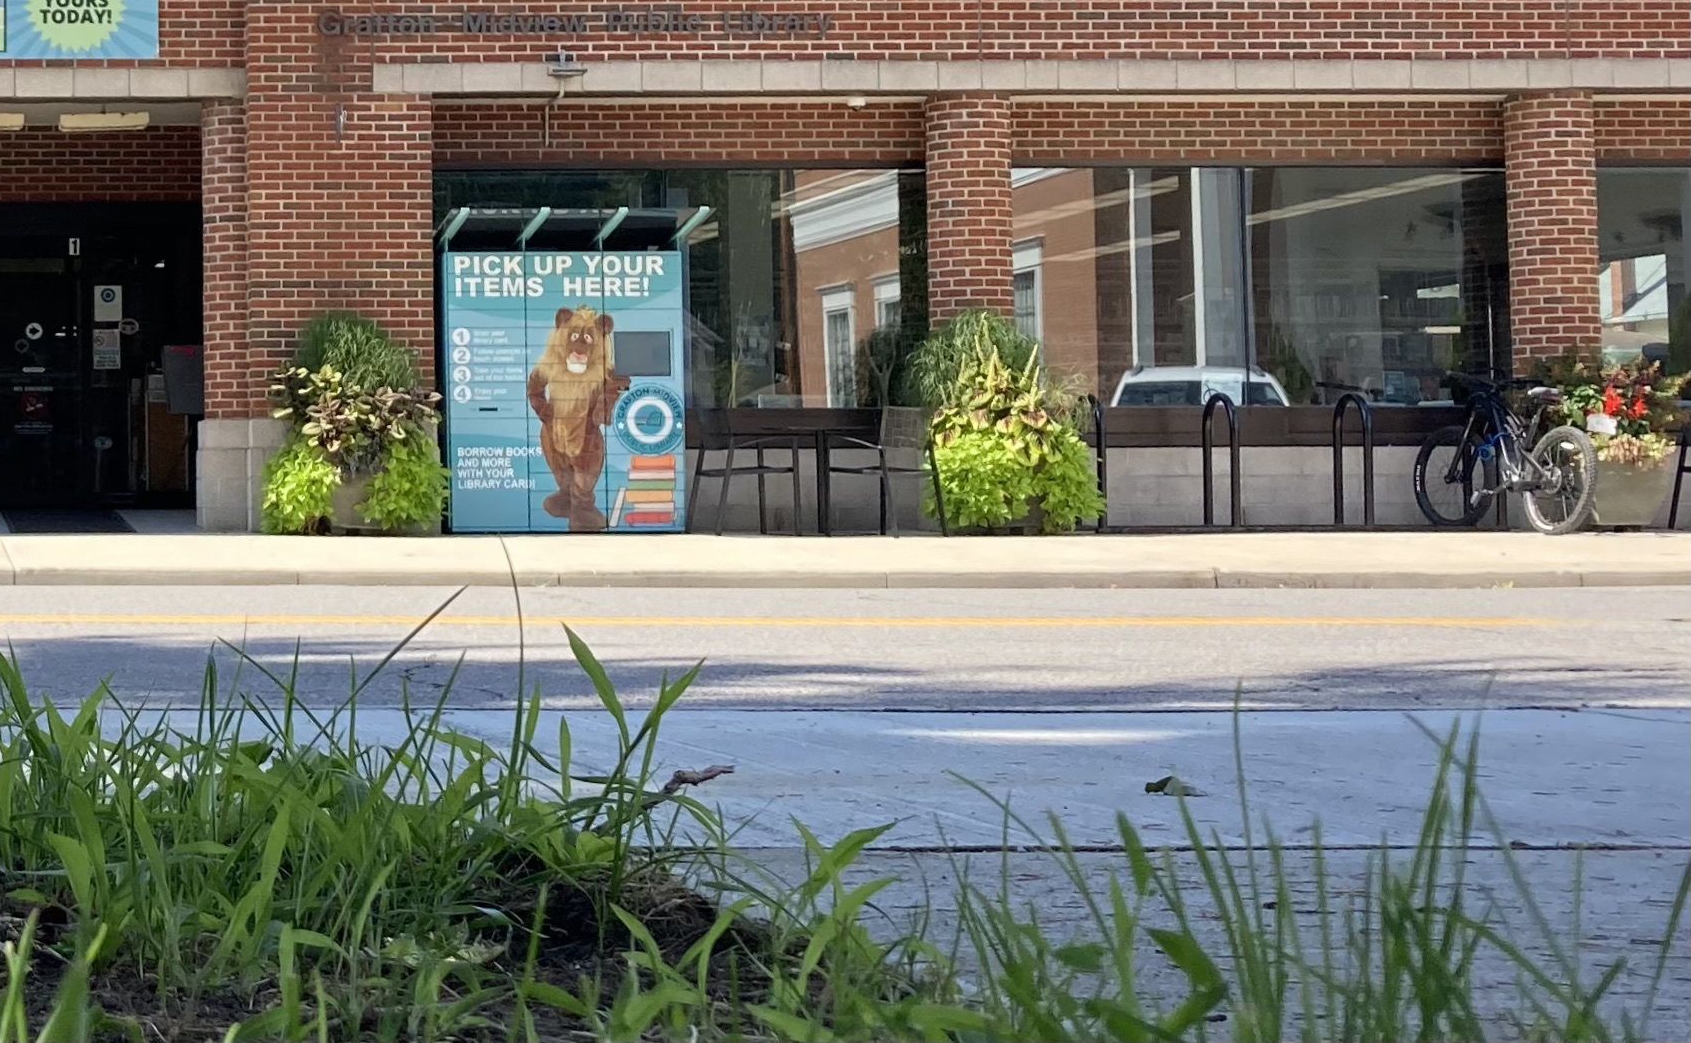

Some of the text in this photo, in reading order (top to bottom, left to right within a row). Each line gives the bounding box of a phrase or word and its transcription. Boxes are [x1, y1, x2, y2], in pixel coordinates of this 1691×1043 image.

[39, 9, 112, 24] TODAY!
[318, 9, 435, 36] Grafton
[462, 10, 587, 35] Midview
[607, 9, 702, 34] Public
[723, 9, 832, 38] Library
[454, 255, 664, 276] PICK UP YOUR
[454, 277, 649, 297] ITEMS HERE!
[457, 446, 543, 457] BORROW BOOKS
[457, 457, 511, 467] AND MORE
[457, 468, 514, 478] WITH YOUR
[458, 479, 502, 489] LIBRARY
